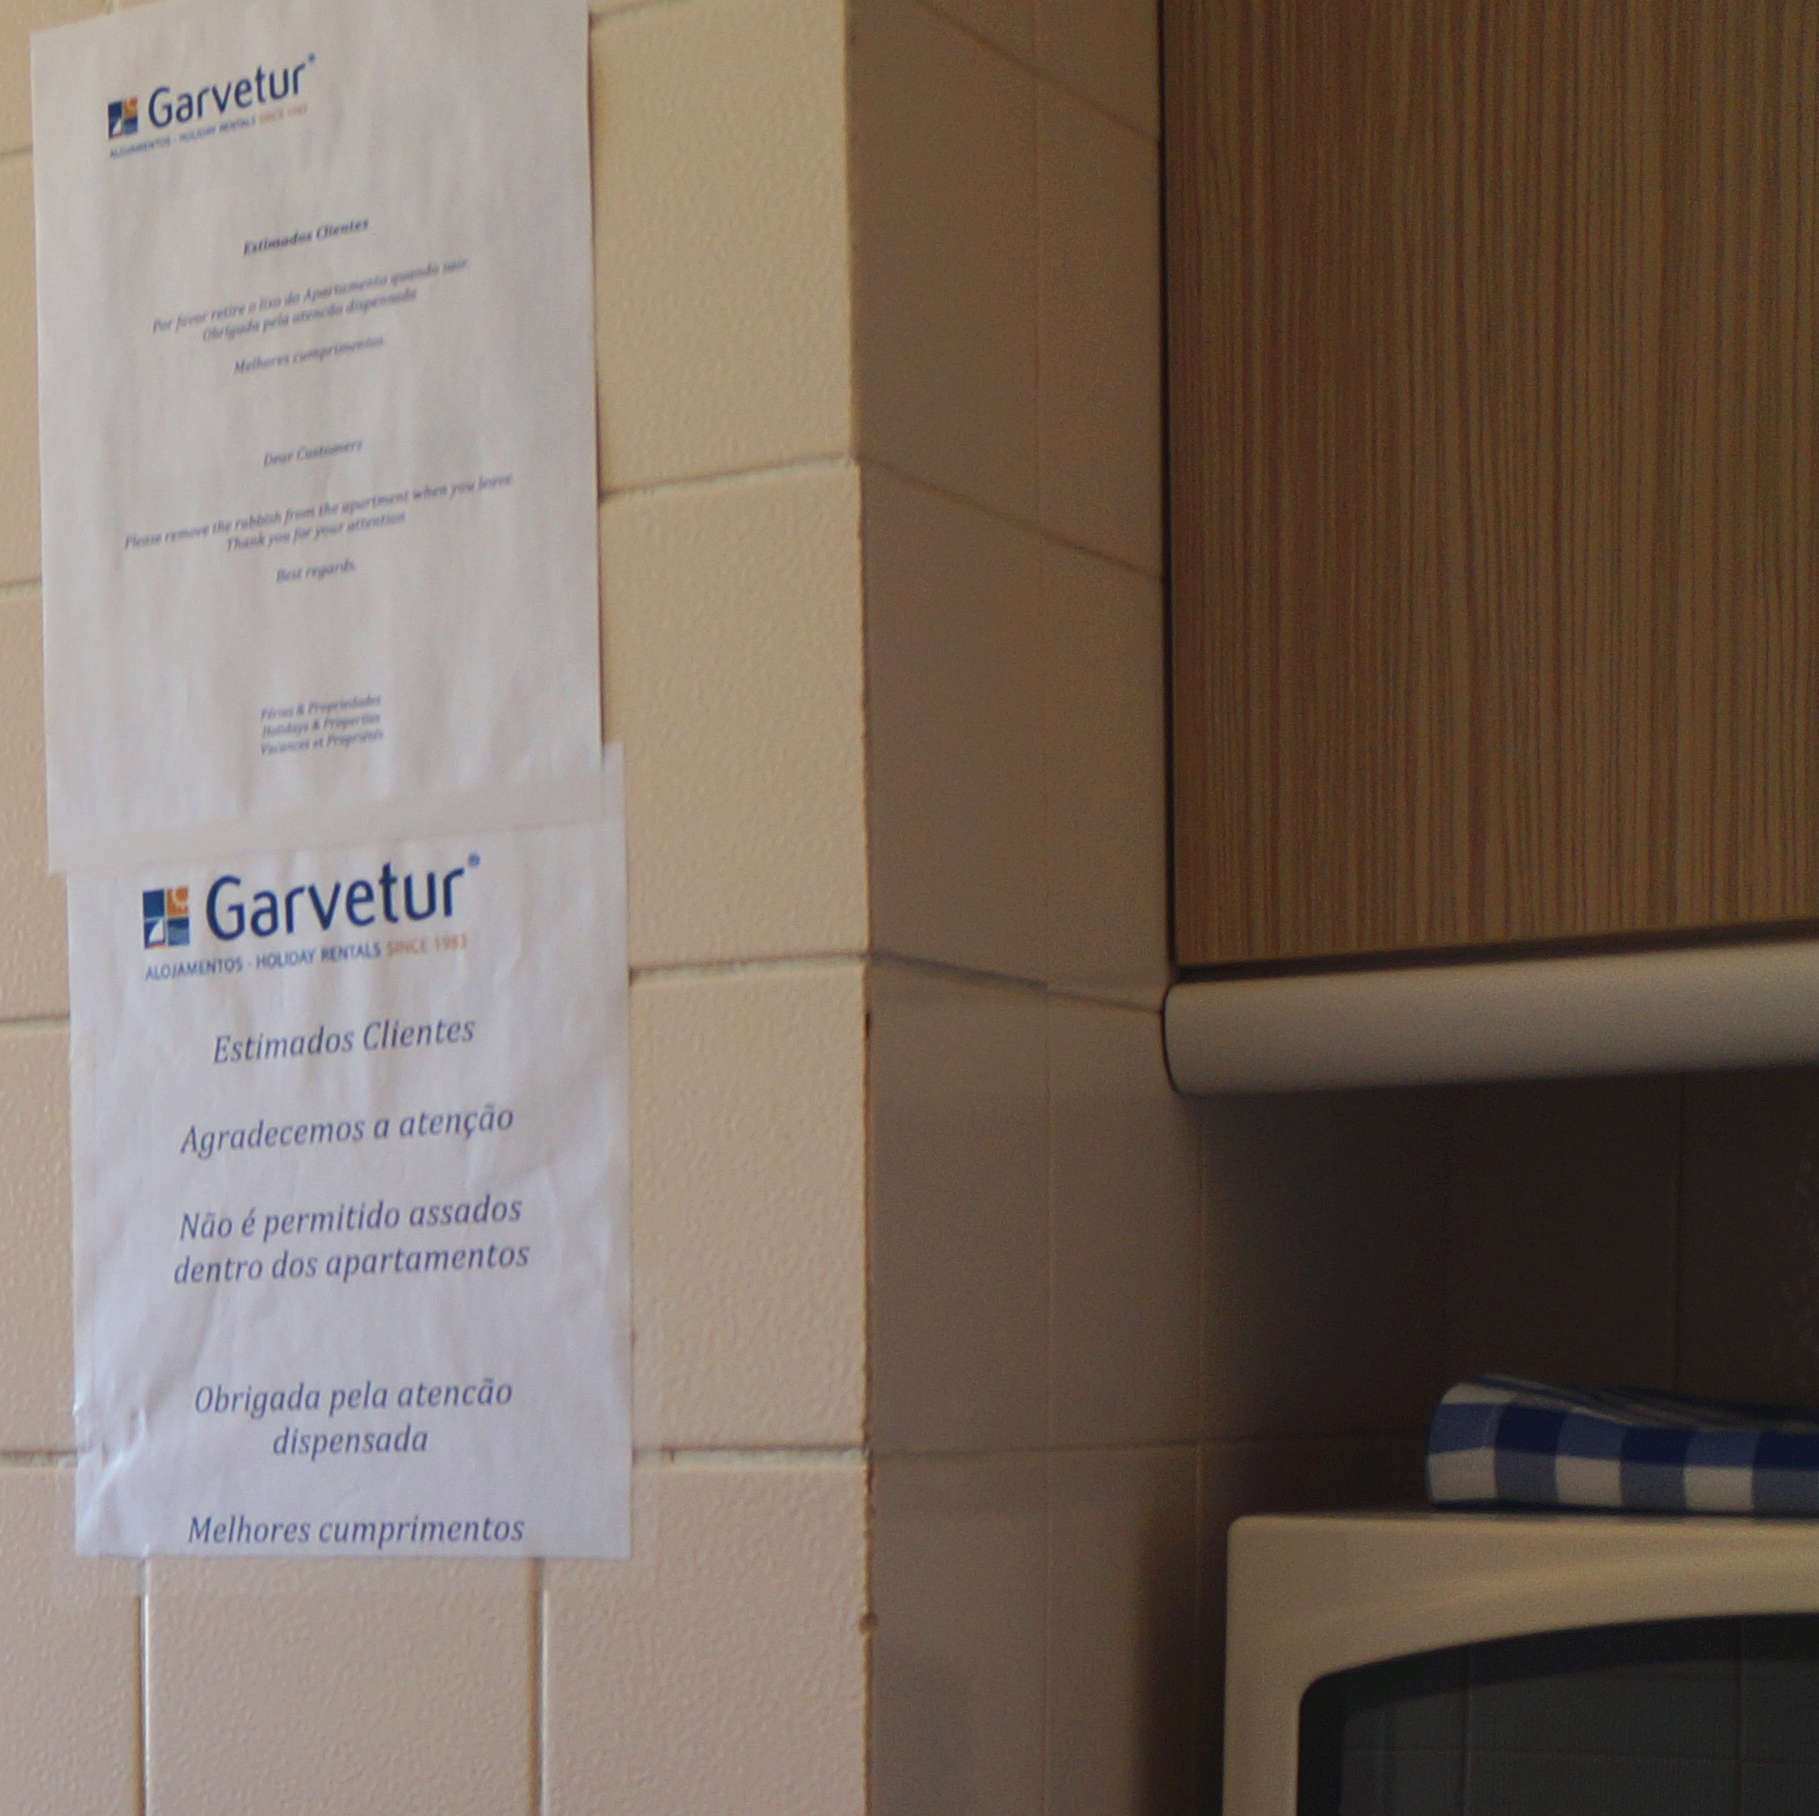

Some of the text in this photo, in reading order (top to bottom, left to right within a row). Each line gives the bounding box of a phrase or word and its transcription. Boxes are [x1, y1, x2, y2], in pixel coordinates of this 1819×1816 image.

[243, 216, 370, 257] Estimados Clientes
[152, 316, 173, 334] Por
[175, 310, 209, 333] favor
[210, 300, 247, 322] retire
[233, 351, 291, 375] Melhores
[262, 438, 363, 468] Dear Customers
[124, 472, 513, 552] Please remove the rubbish from the apartment when you leave
[226, 534, 265, 553] Thank
[264, 531, 292, 549] you
[290, 524, 312, 546] for
[345, 511, 406, 534] attention
[275, 564, 303, 584] Best
[205, 860, 466, 941] Garvetur
[144, 956, 244, 981] ALOJAMENTOS
[255, 948, 317, 971] HOLIDAY
[320, 941, 382, 963] RENTALS
[386, 935, 428, 957] SINCE
[212, 1017, 477, 1065] Estimados Clientes
[180, 1102, 516, 1161] Agradecemos a atenção
[179, 1192, 525, 1244] Não é permitido assados
[172, 1240, 532, 1286] dentro dos apartamentos
[194, 1380, 322, 1421] Obrigada
[327, 1379, 389, 1418] pela
[272, 1422, 429, 1463] dispensada
[187, 1513, 527, 1551] Melhores cumprimentos
